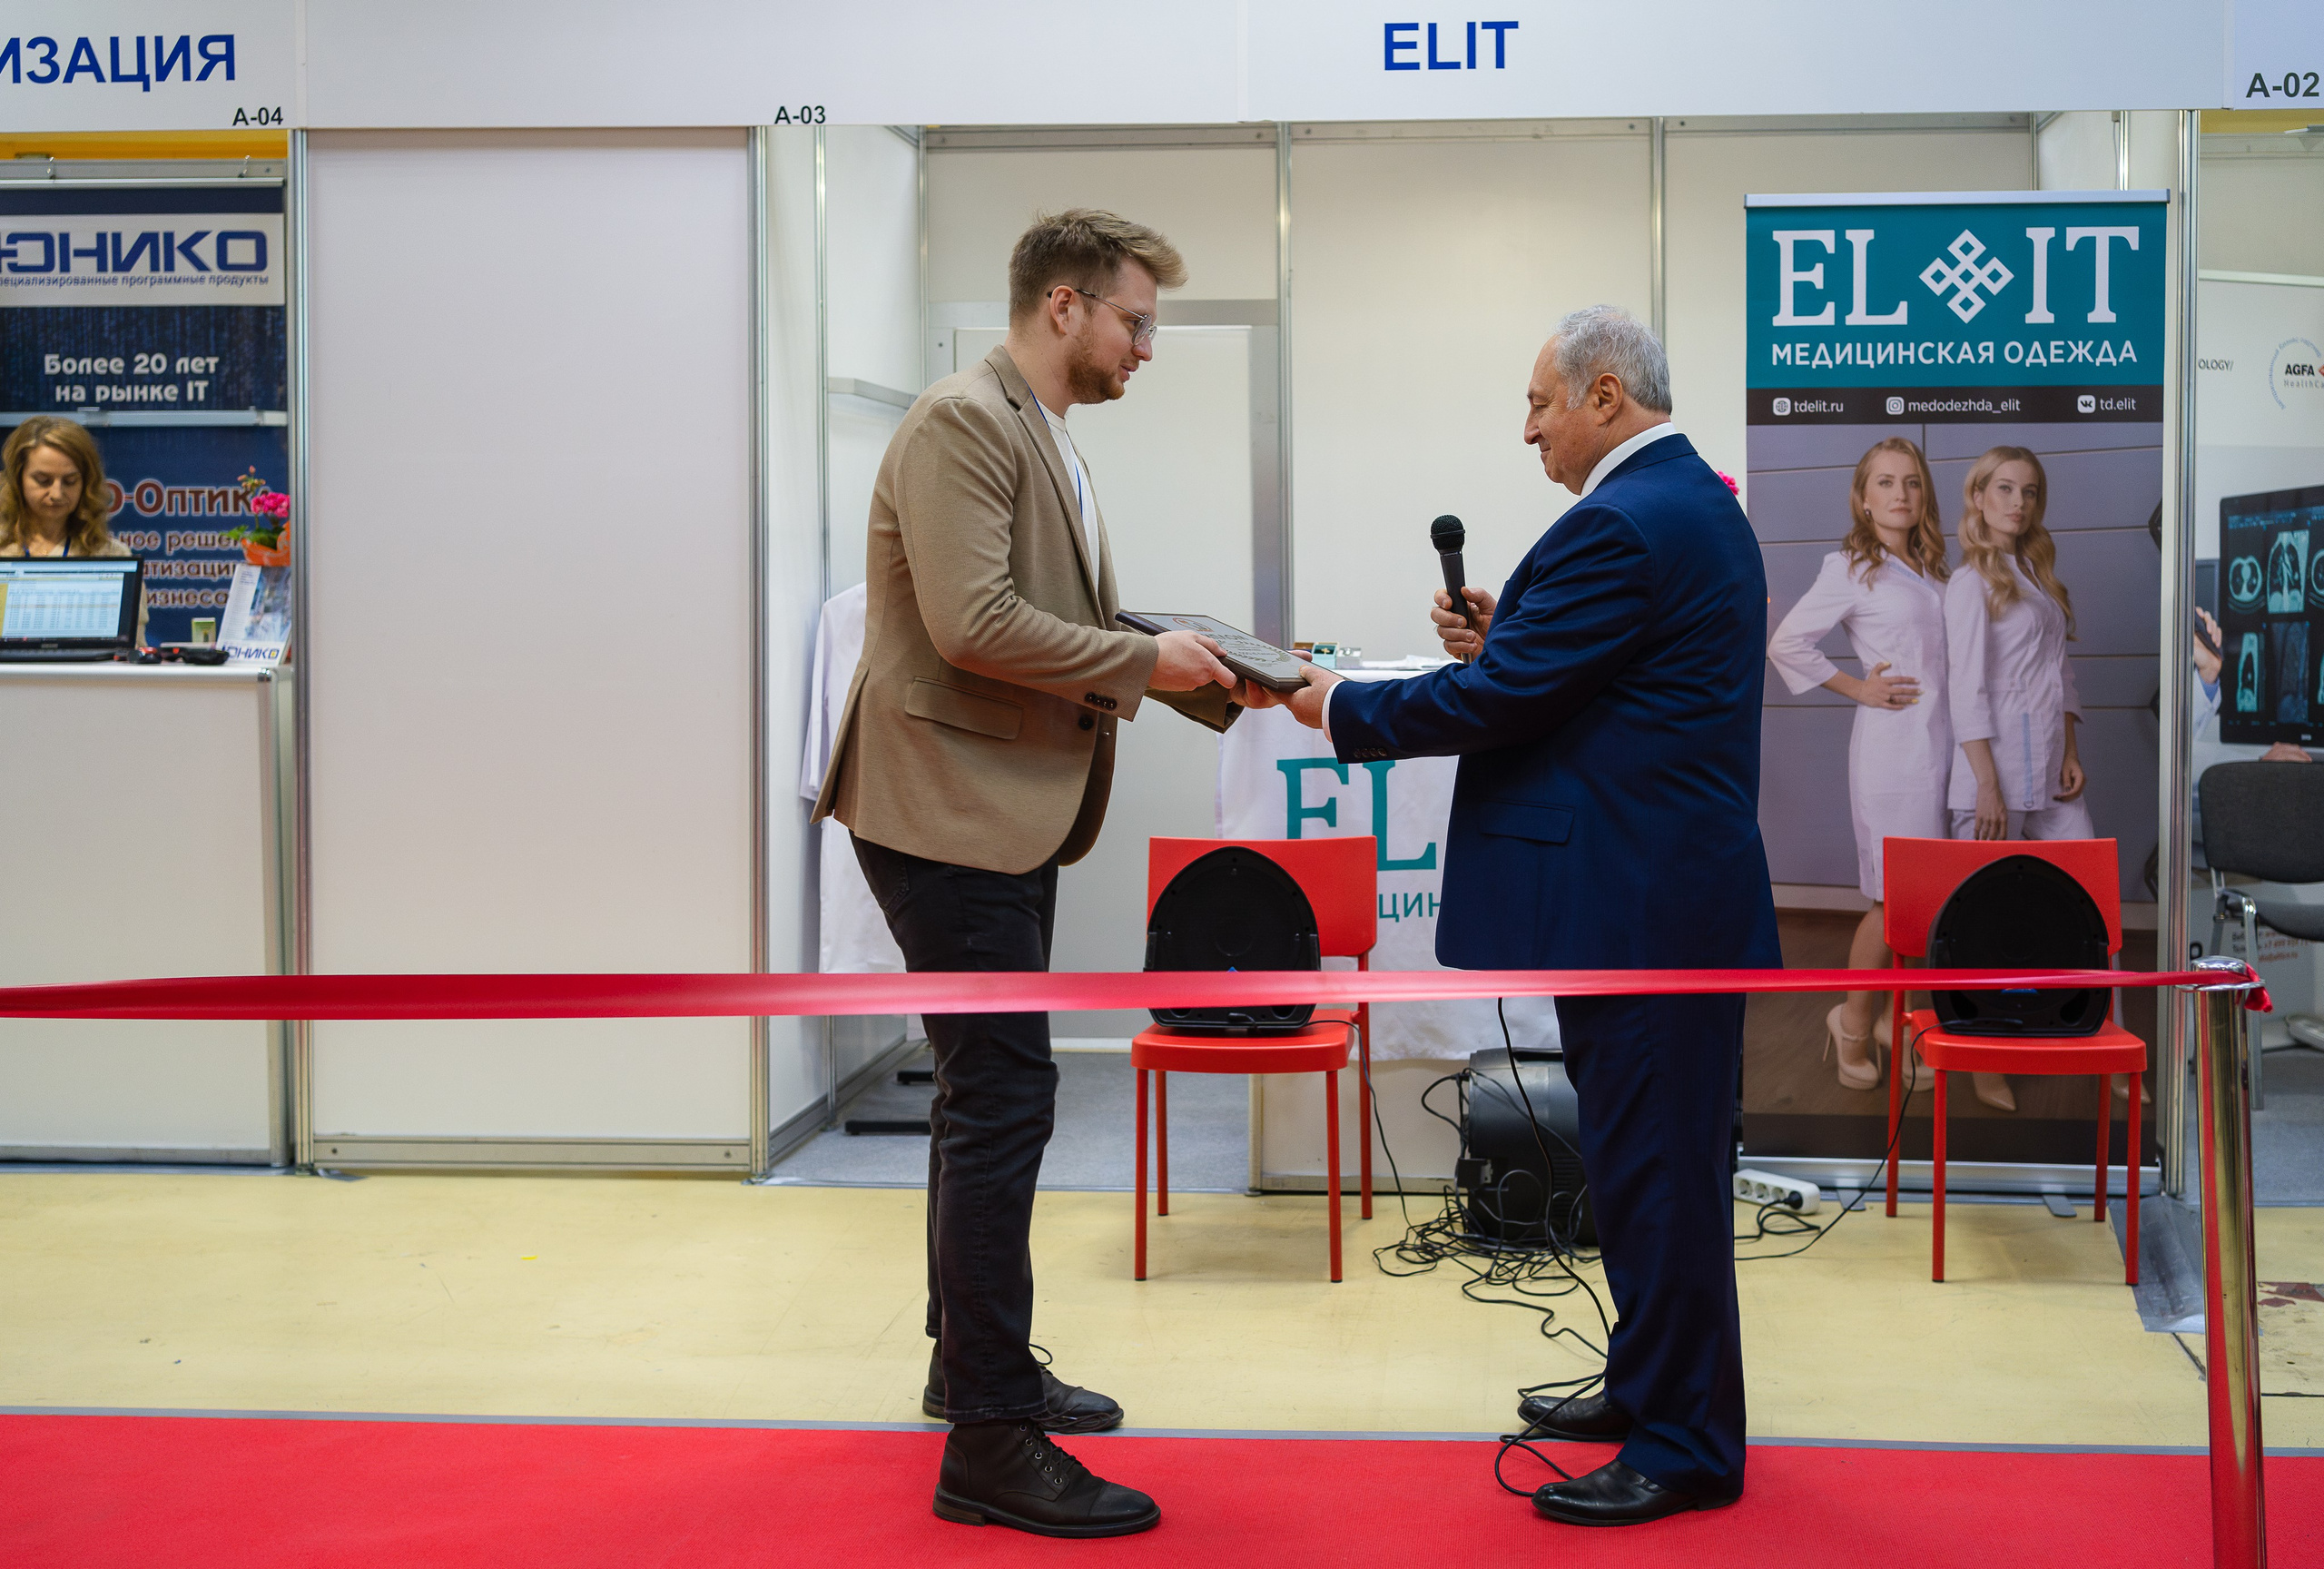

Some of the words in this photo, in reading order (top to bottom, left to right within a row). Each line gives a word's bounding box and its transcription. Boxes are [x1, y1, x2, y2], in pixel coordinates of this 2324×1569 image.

[1384, 21, 1519, 70] ELIT
[2246, 72, 2319, 98] A-02
[232, 106, 283, 125] A-04
[774, 105, 826, 124] A-03
[122, 274, 205, 288] программные
[208, 274, 270, 288] продукты
[44, 353, 124, 375] Более
[133, 352, 167, 374] 20
[175, 356, 220, 374] лет
[1772, 341, 1994, 368] МЕДИЦИНСКАЯ
[2004, 340, 2138, 367] ОДЕЖДА
[2285, 363, 2315, 376] AGFA
[55, 382, 86, 401] на
[96, 383, 179, 402] рынке
[186, 381, 209, 400] IT
[1794, 400, 1844, 412] tdelit.ru
[1908, 399, 2021, 414] medodezhda_elit
[2100, 397, 2136, 410] td.elit
